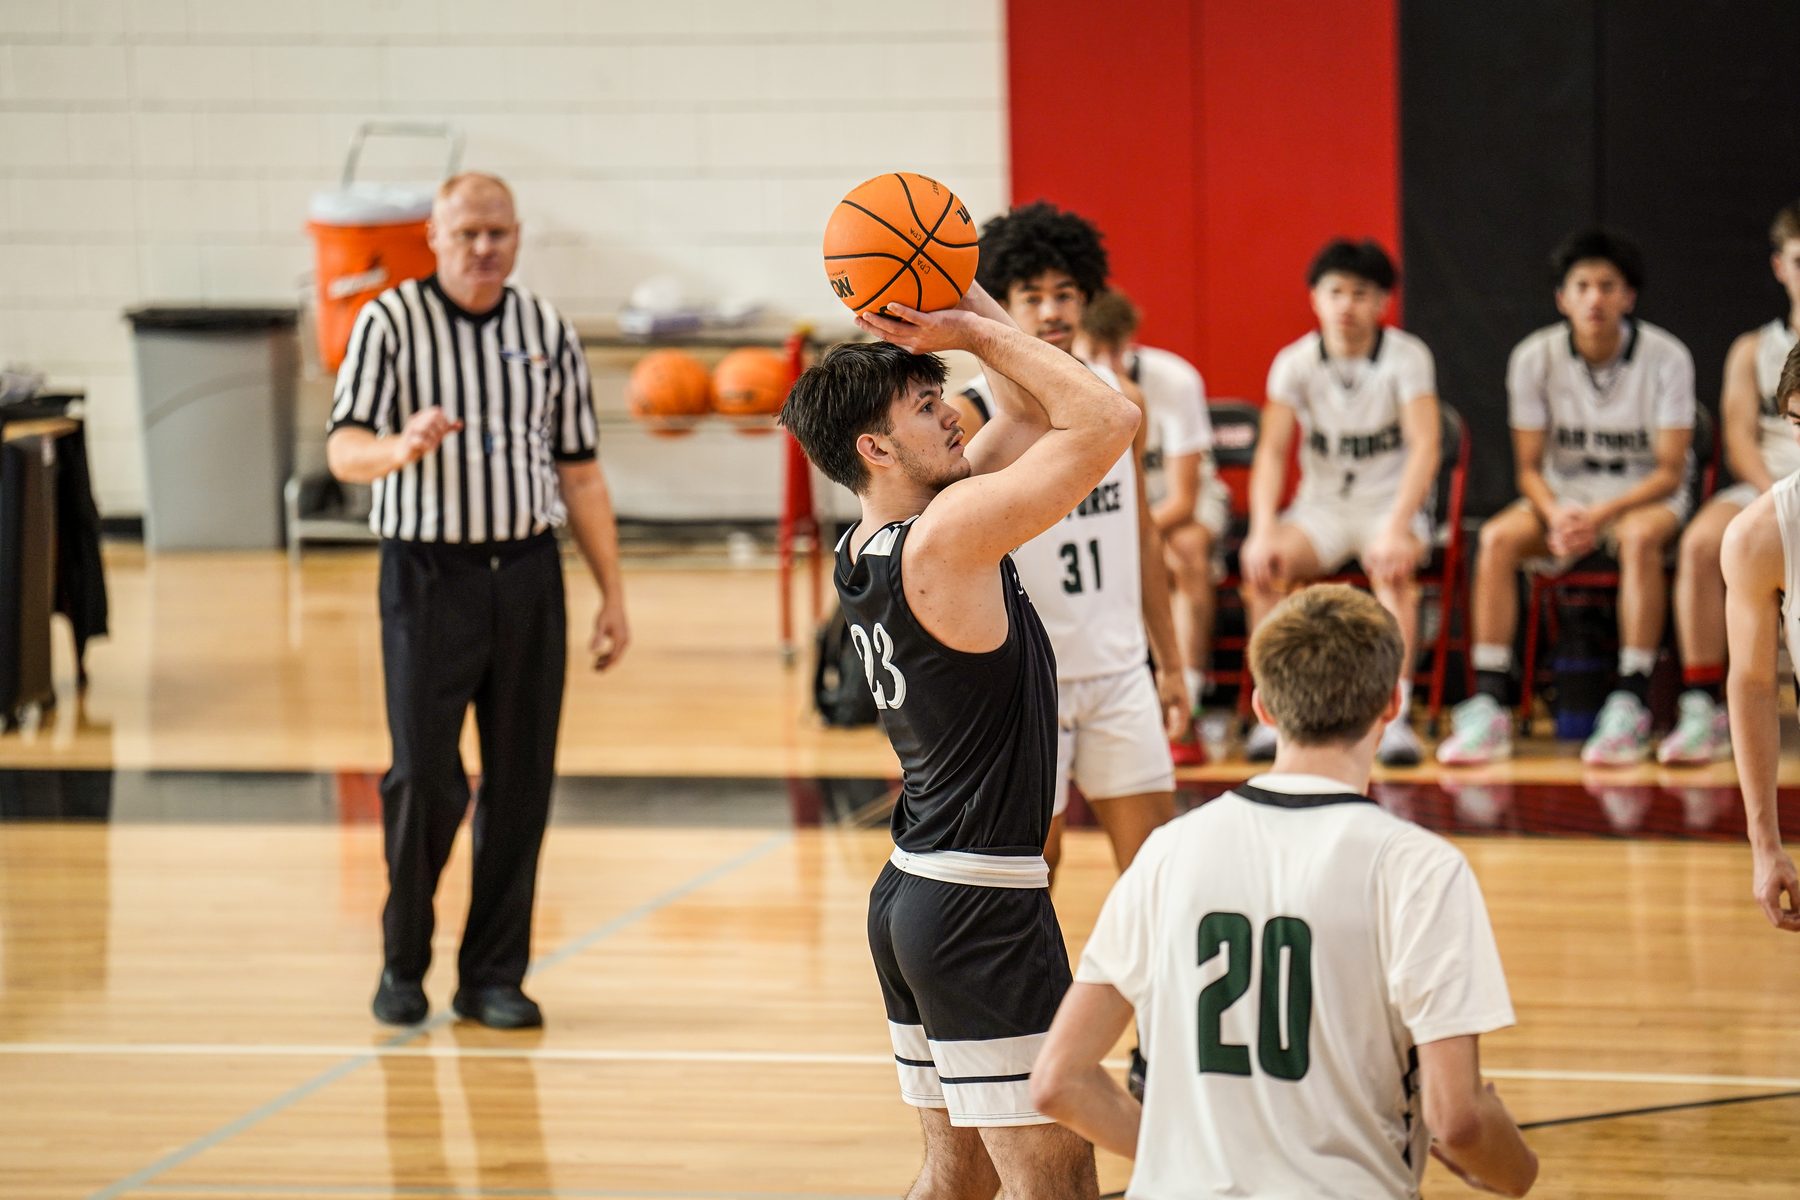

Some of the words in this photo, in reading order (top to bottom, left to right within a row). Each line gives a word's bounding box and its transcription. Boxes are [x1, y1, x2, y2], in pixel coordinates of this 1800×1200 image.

[917, 257, 931, 275] CPA
[1059, 539, 1102, 595] 31
[850, 622, 907, 710] 23
[1197, 911, 1313, 1082] 20
